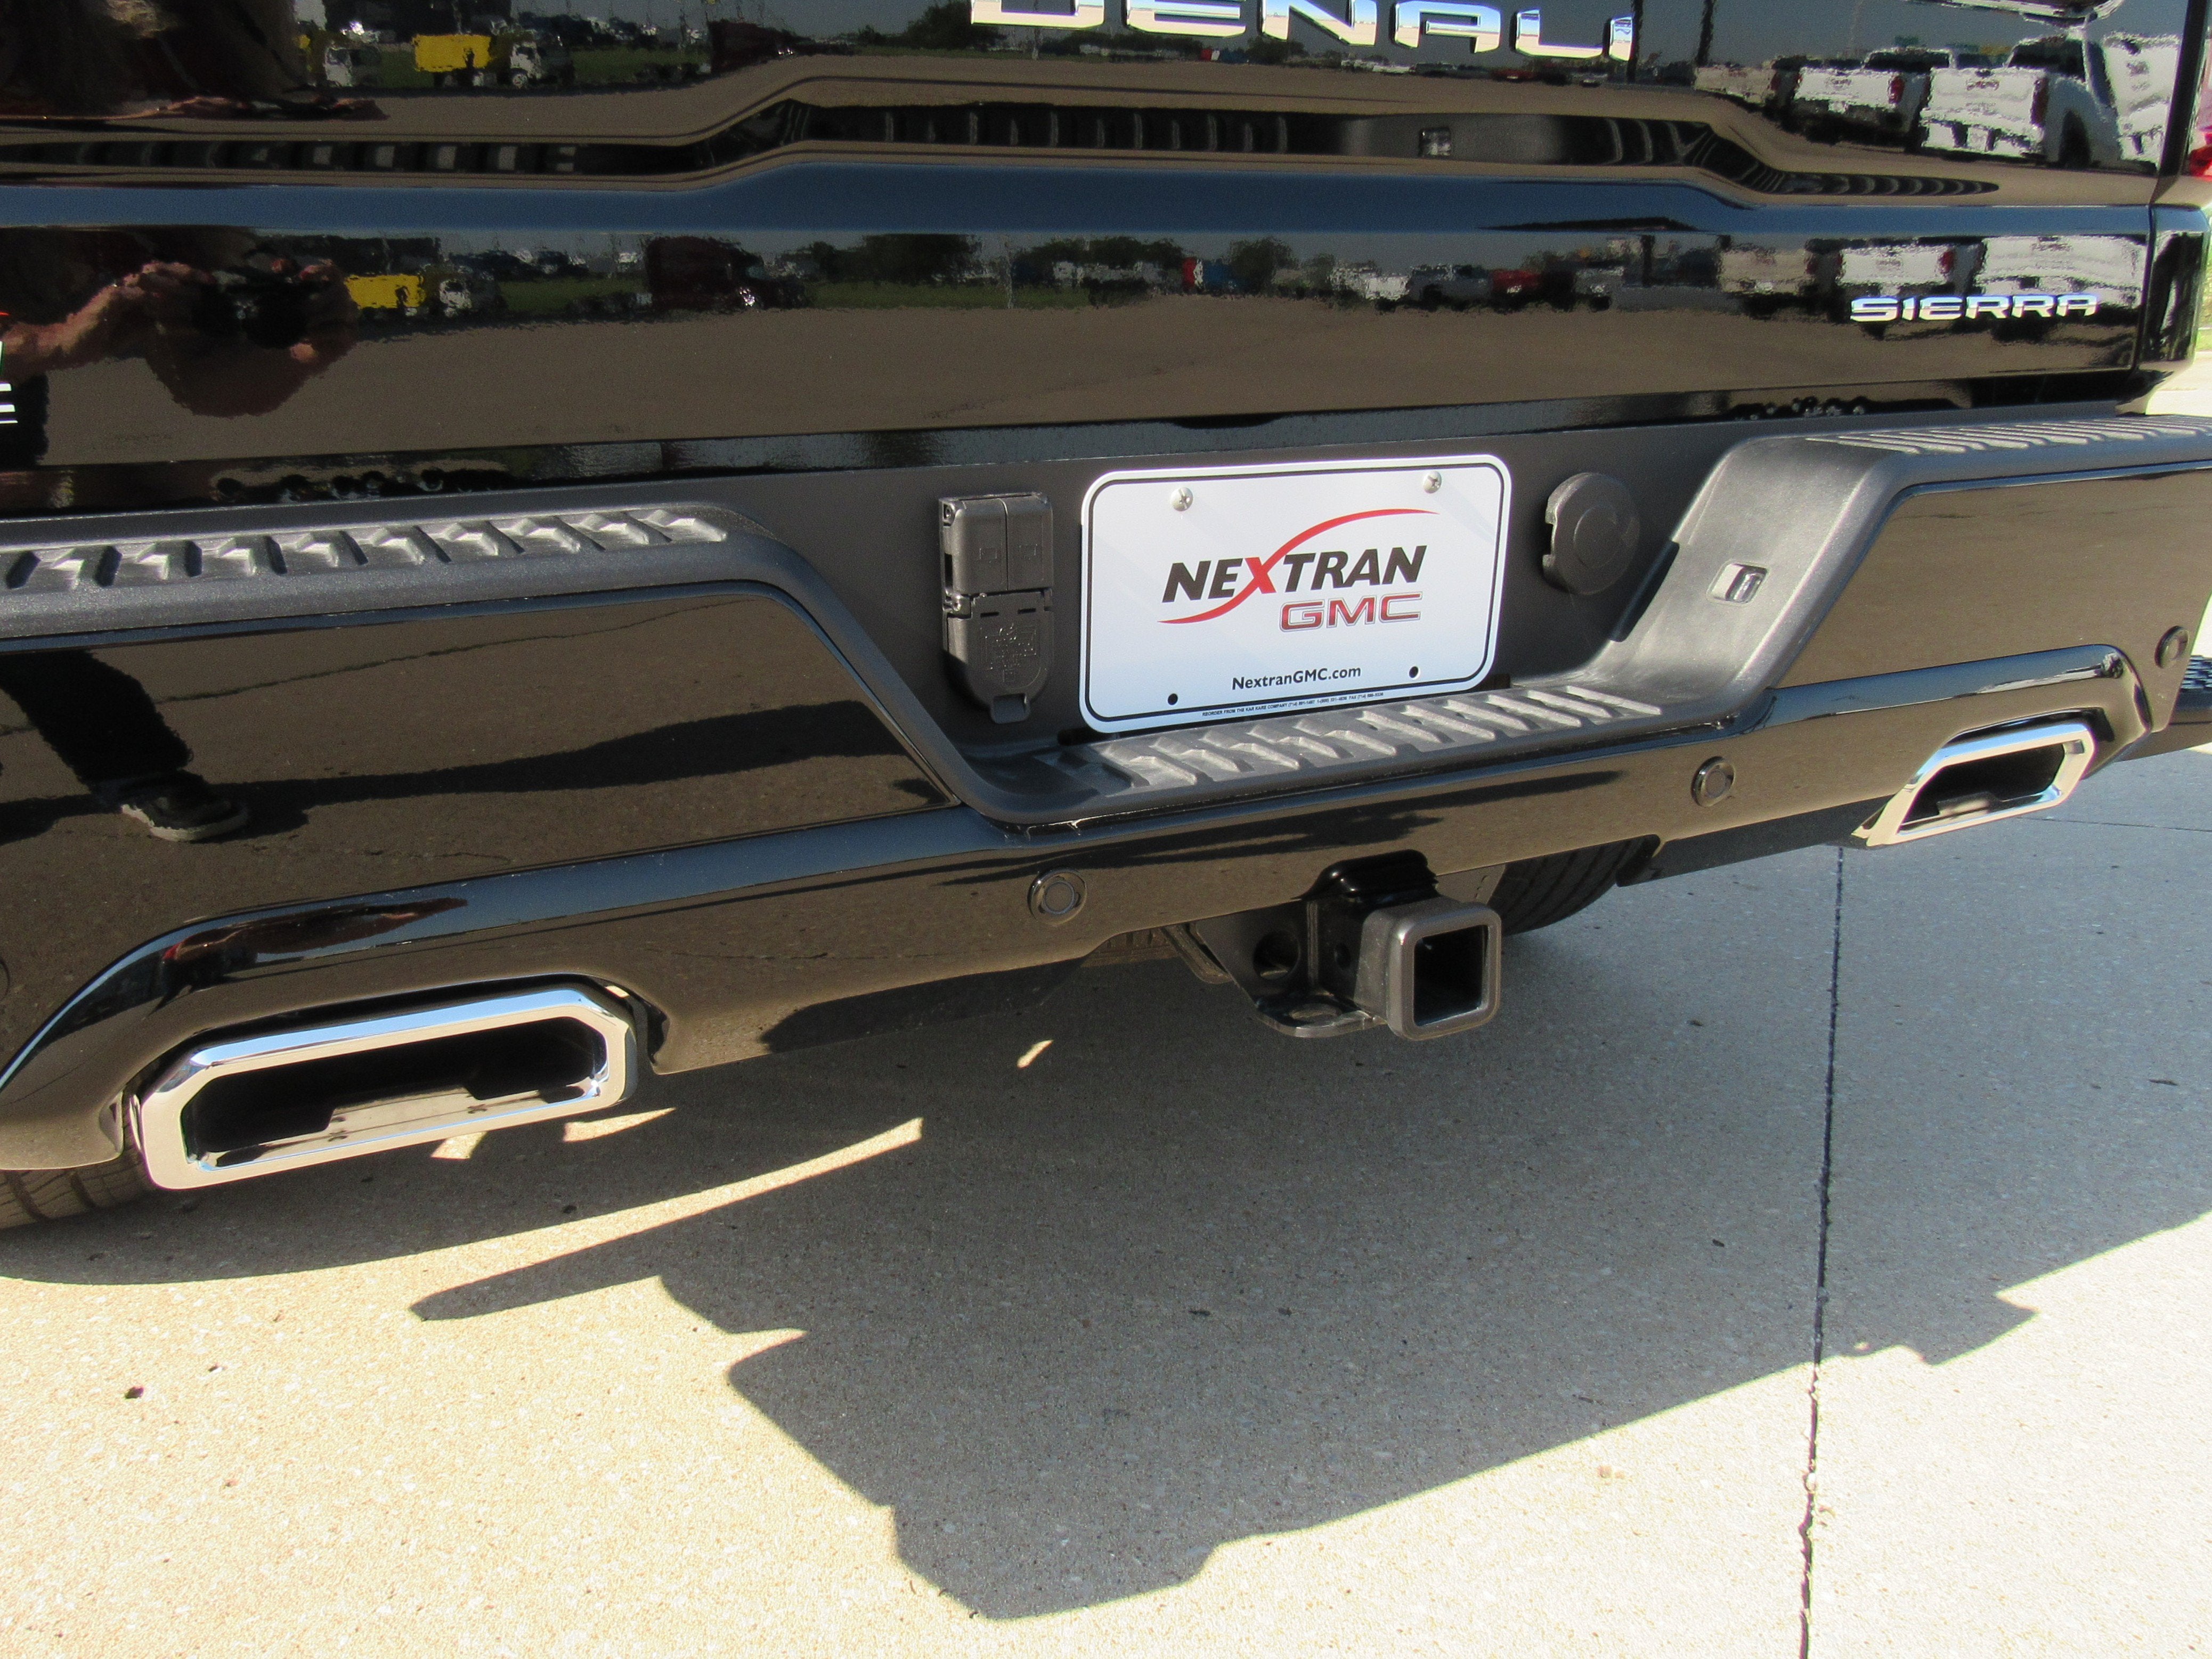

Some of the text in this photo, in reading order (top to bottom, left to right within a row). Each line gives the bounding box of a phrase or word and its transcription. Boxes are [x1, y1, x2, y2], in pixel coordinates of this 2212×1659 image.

[971, 0, 1633, 61] DENALI
[1851, 292, 2097, 322] SIERRA
[1161, 545, 1427, 603] NEXTRAN
[1279, 591, 1423, 632] GMC
[1232, 667, 1362, 690] NextranGMC.com
